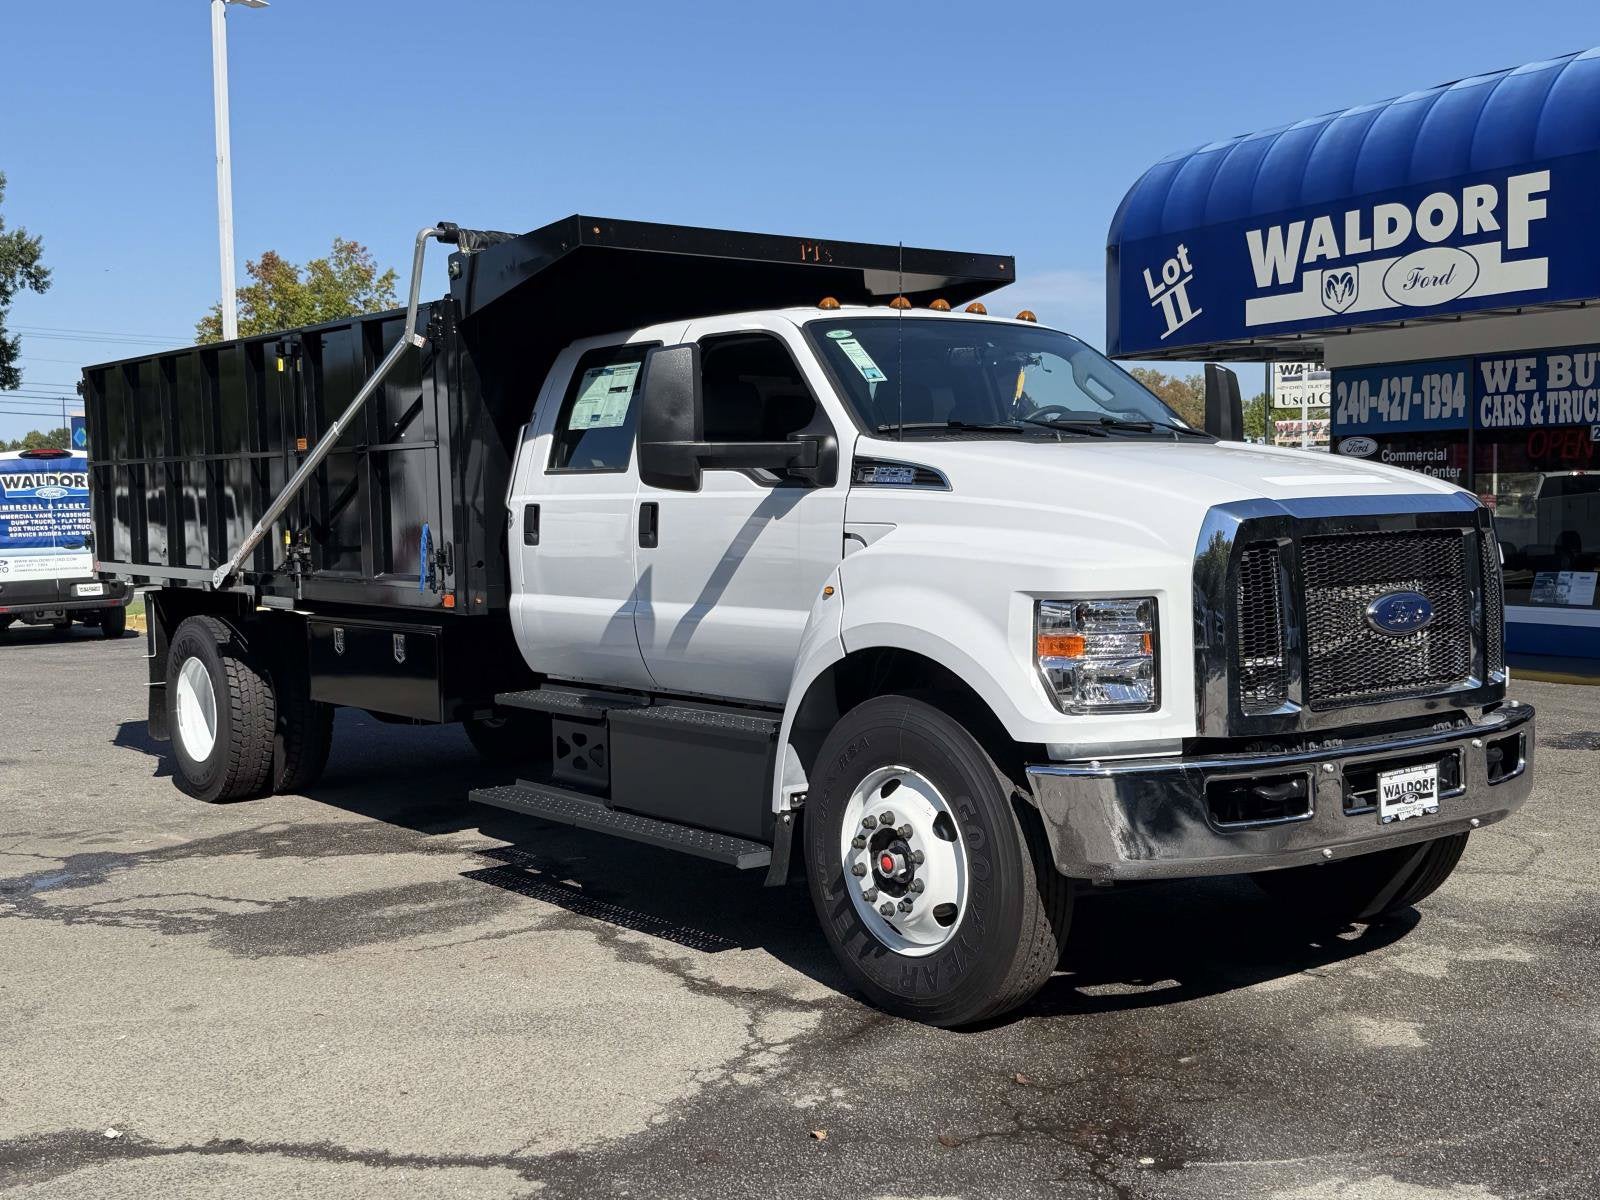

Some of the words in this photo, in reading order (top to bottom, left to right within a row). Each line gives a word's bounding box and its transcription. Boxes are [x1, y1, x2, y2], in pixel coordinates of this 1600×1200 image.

[1245, 169, 1551, 289] WALDORF
[1143, 243, 1193, 299] Lot
[1402, 262, 1457, 291] Ford
[1280, 363, 1330, 376] WALD
[1480, 358, 1537, 394] WE
[1547, 352, 1600, 388] BU
[1336, 372, 1466, 426] 240-427-1394
[1480, 393, 1526, 427] CARS
[1530, 392, 1544, 425] &
[1547, 389, 1600, 424] TRUC
[1345, 440, 1369, 453] Ford
[1381, 448, 1447, 462] Commercial
[1527, 429, 1595, 460] OPEN
[1, 474, 88, 490] WALDOR
[1424, 465, 1462, 478] Center
[0, 503, 44, 512] MERCIAL
[1384, 778, 1435, 798] WALDORF
